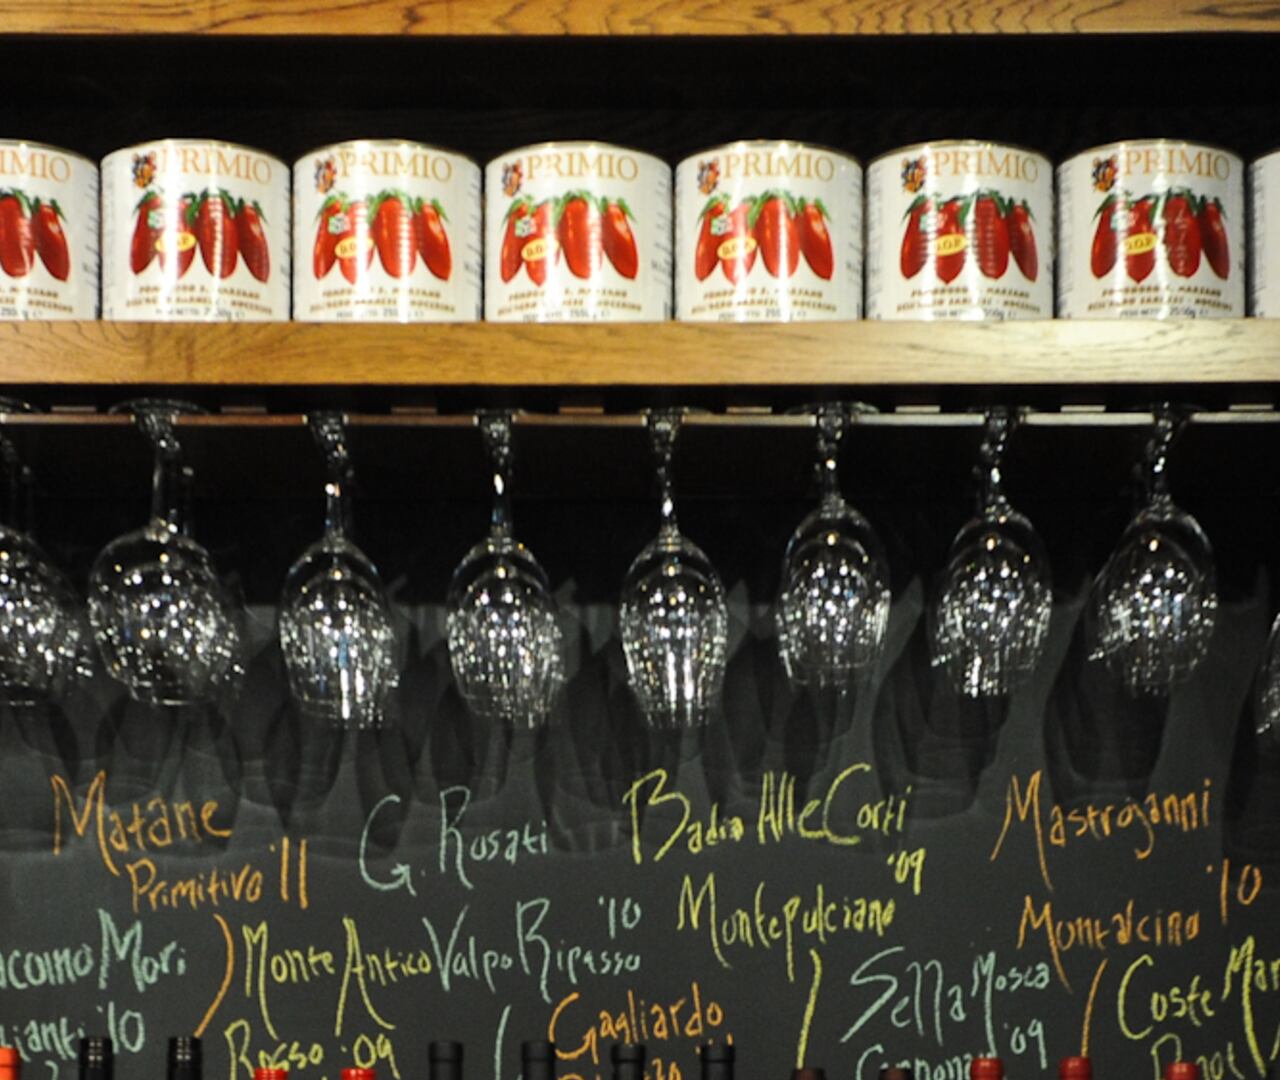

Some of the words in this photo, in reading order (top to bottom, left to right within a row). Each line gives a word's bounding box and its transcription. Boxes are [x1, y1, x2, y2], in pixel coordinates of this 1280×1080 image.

[340, 150, 453, 183] PRIMIO
[527, 150, 640, 181] PRIMIO
[724, 151, 835, 182] PRIMIO
[933, 150, 1038, 182] PRIMIO
[1124, 148, 1230, 182] PRIMIO
[50, 769, 232, 877] Matane
[125, 861, 264, 914] Primitivo
[677, 872, 897, 982] Montepulciano
[96, 907, 187, 992] Mori
[242, 919, 336, 1040] Monte
[336, 915, 432, 1037] Antico
[421, 904, 514, 994] Valpo
[1016, 895, 1200, 994] Montalcino
[547, 979, 725, 1063] Gagliardo
[839, 946, 967, 1045] Sella
[970, 951, 1051, 1057] Mosca
[1117, 954, 1216, 1040] Coste
